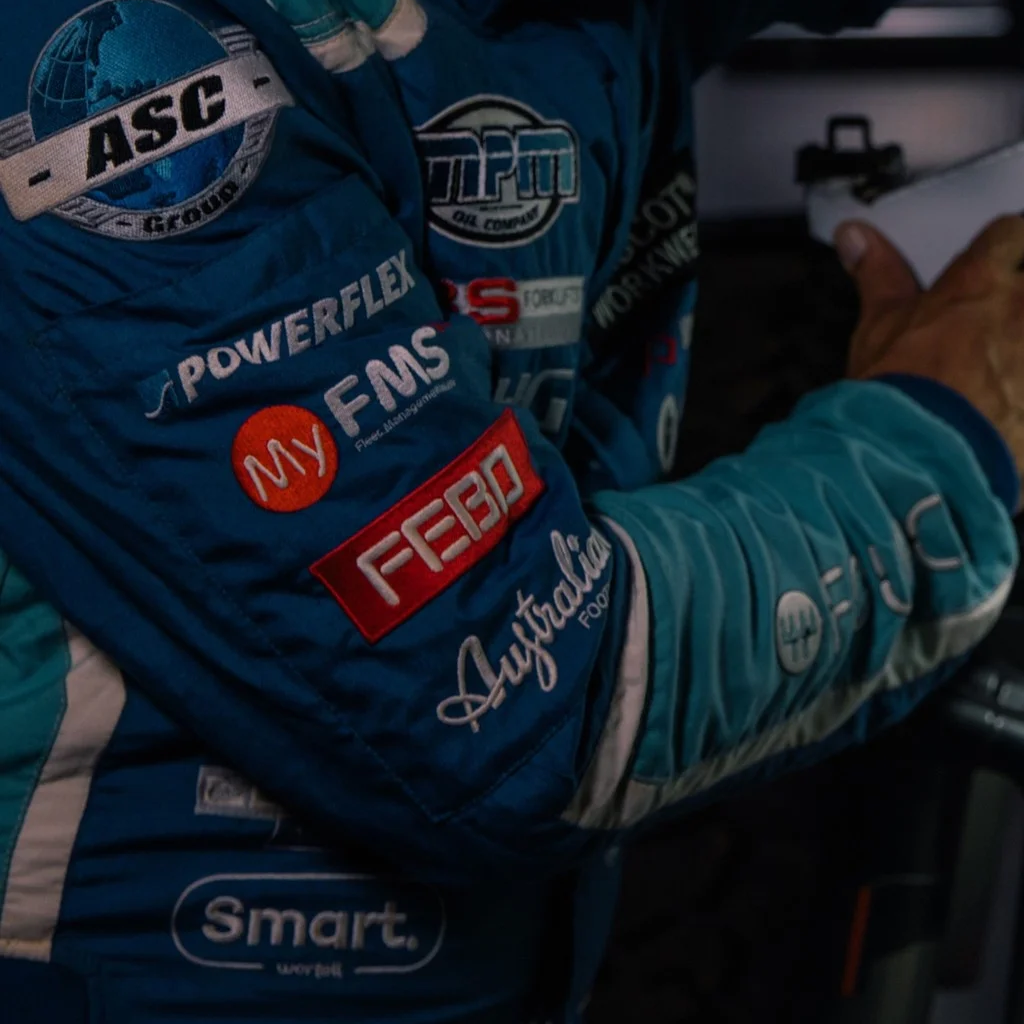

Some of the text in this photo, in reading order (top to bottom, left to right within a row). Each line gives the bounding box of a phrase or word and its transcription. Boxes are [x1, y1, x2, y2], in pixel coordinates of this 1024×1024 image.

[86, 74, 226, 180] ASC
[143, 180, 239, 234] Group
[452, 205, 540, 231] OIL COMPANY
[177, 249, 416, 404] POWERFLEX
[323, 326, 450, 438] FMS
[201, 894, 420, 952] Smart.
